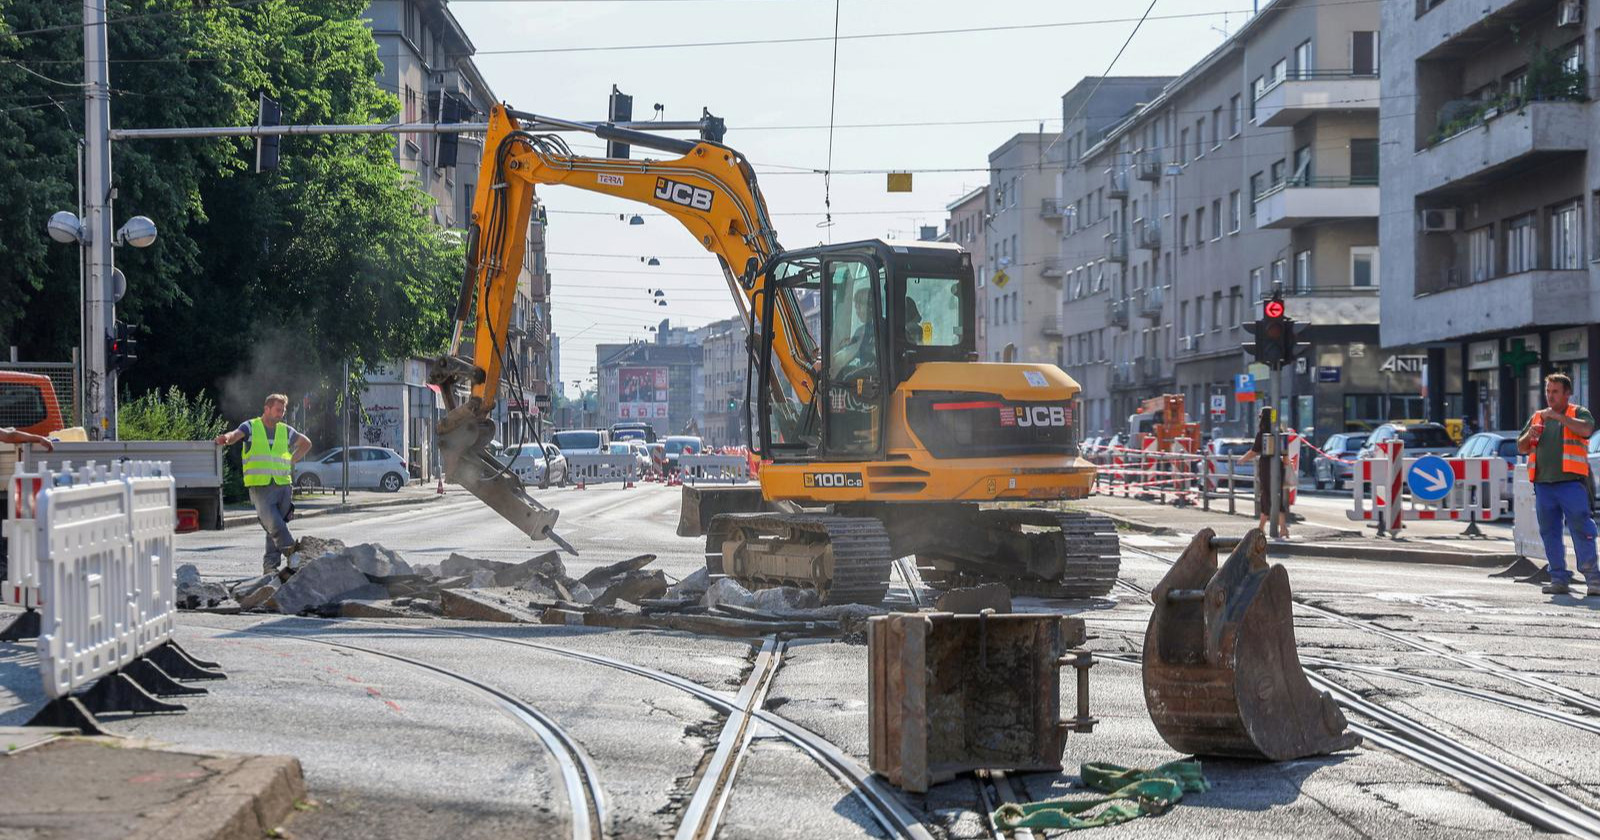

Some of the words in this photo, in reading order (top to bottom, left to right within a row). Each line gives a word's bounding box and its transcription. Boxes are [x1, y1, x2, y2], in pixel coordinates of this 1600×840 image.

[599, 175, 622, 185] TERRA
[655, 180, 713, 211] JCB
[1240, 374, 1250, 389] P
[1017, 406, 1066, 427] JCB
[815, 473, 845, 487] 100
